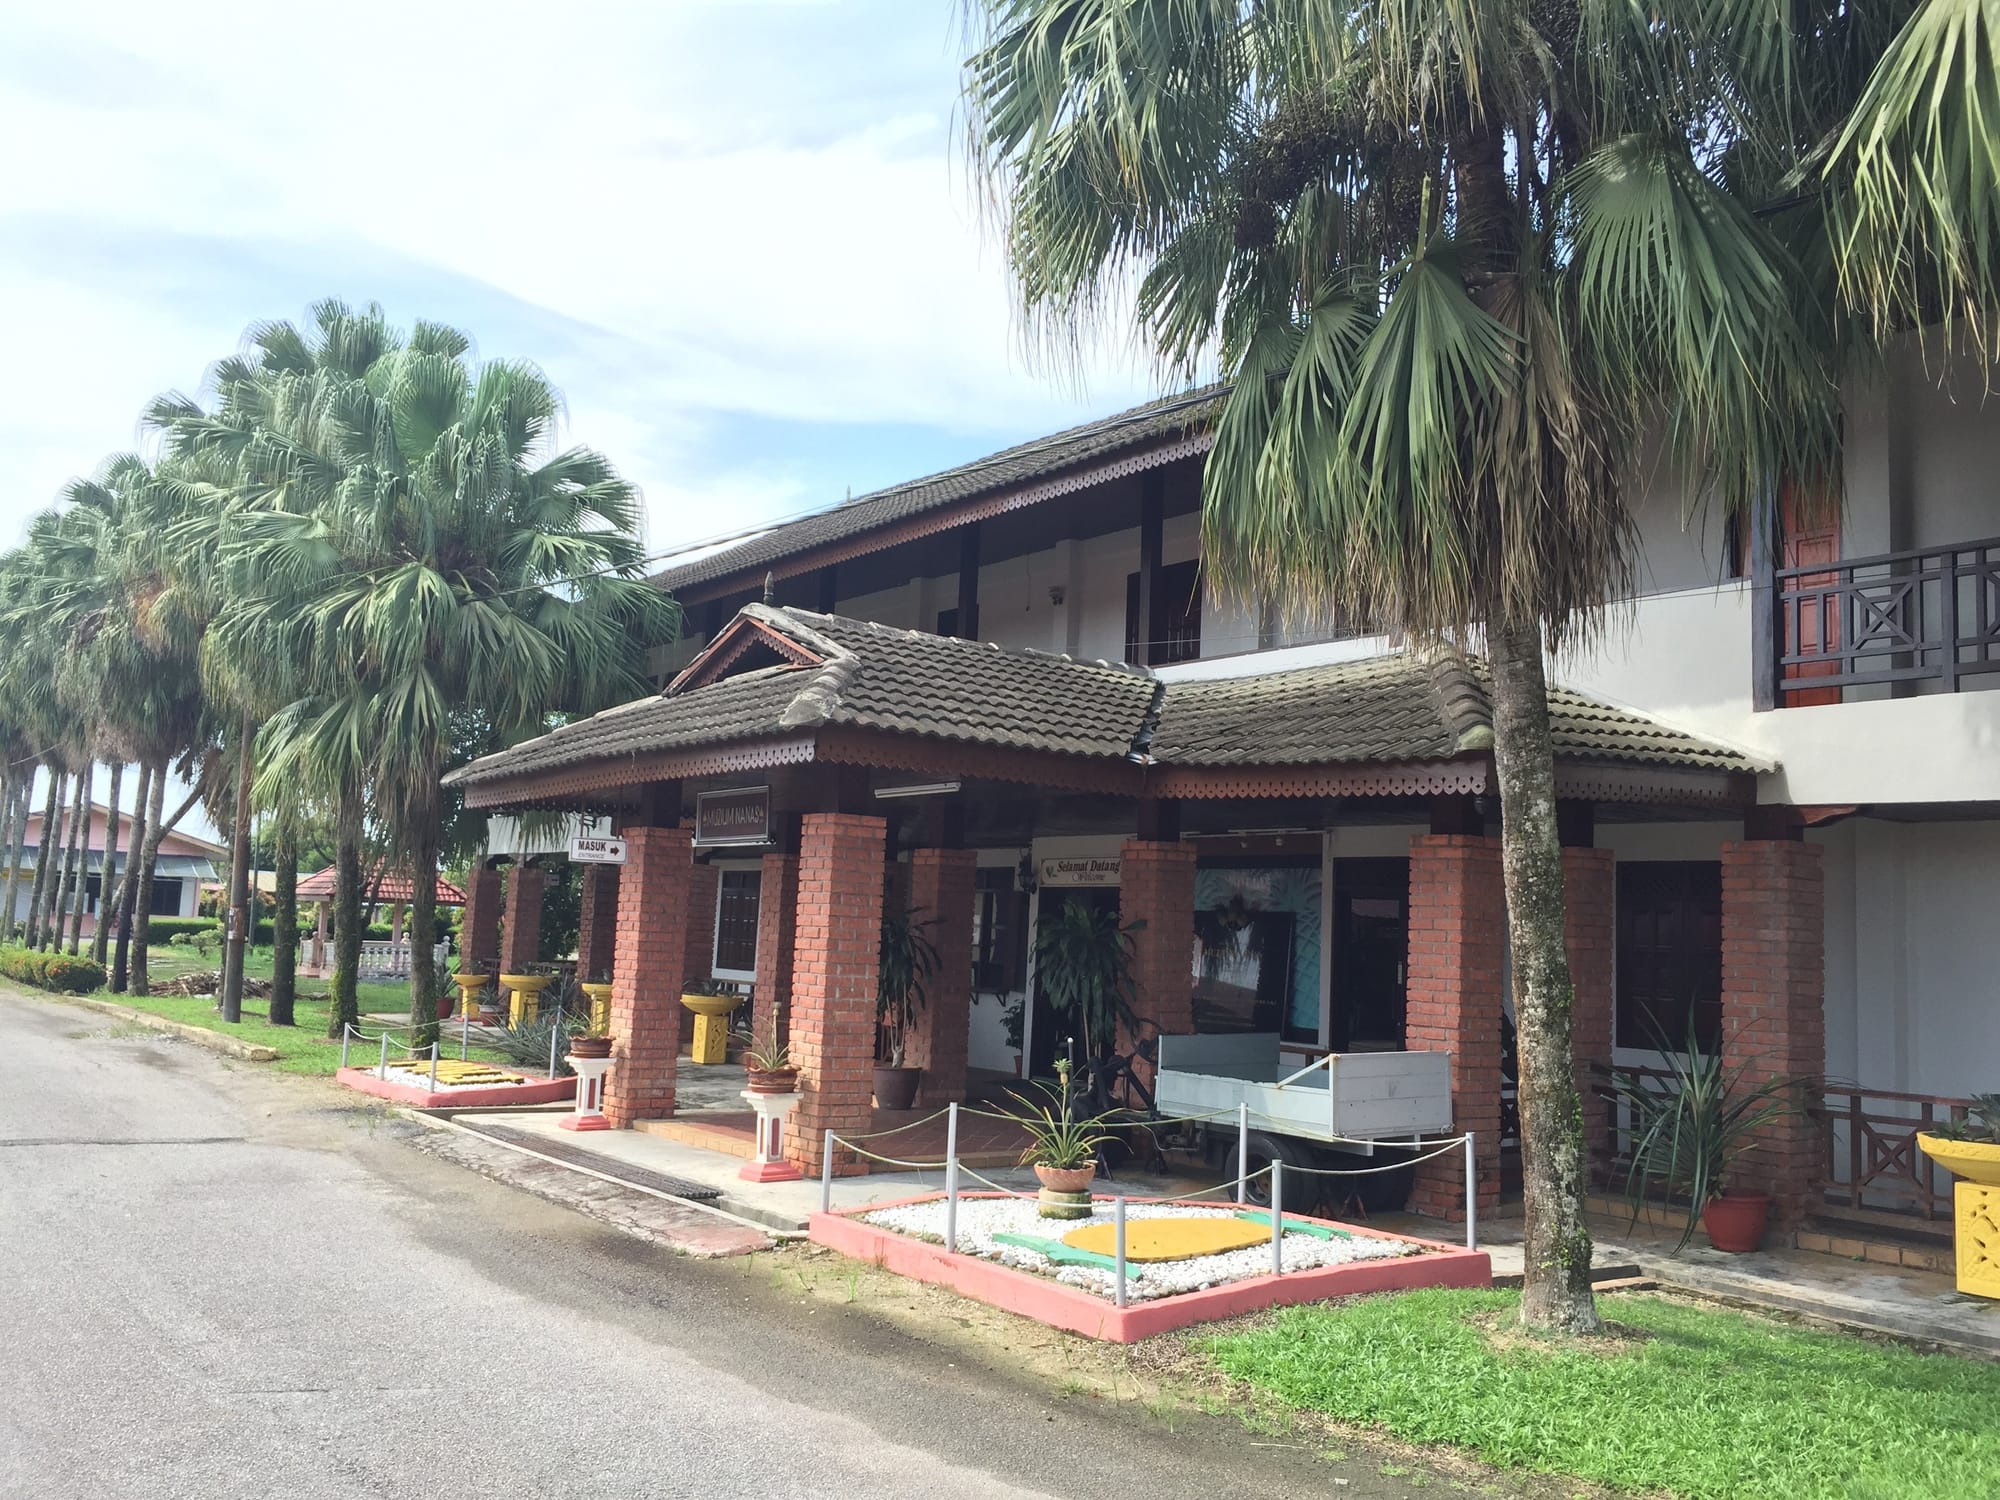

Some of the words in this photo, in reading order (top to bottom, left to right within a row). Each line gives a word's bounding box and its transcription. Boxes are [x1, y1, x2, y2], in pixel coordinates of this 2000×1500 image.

[706, 808, 734, 826] MUZIUM
[735, 805, 760, 824] NANAS
[578, 840, 607, 852] MASUK
[1057, 860, 1089, 873] Selamat
[1090, 860, 1120, 874] Datang
